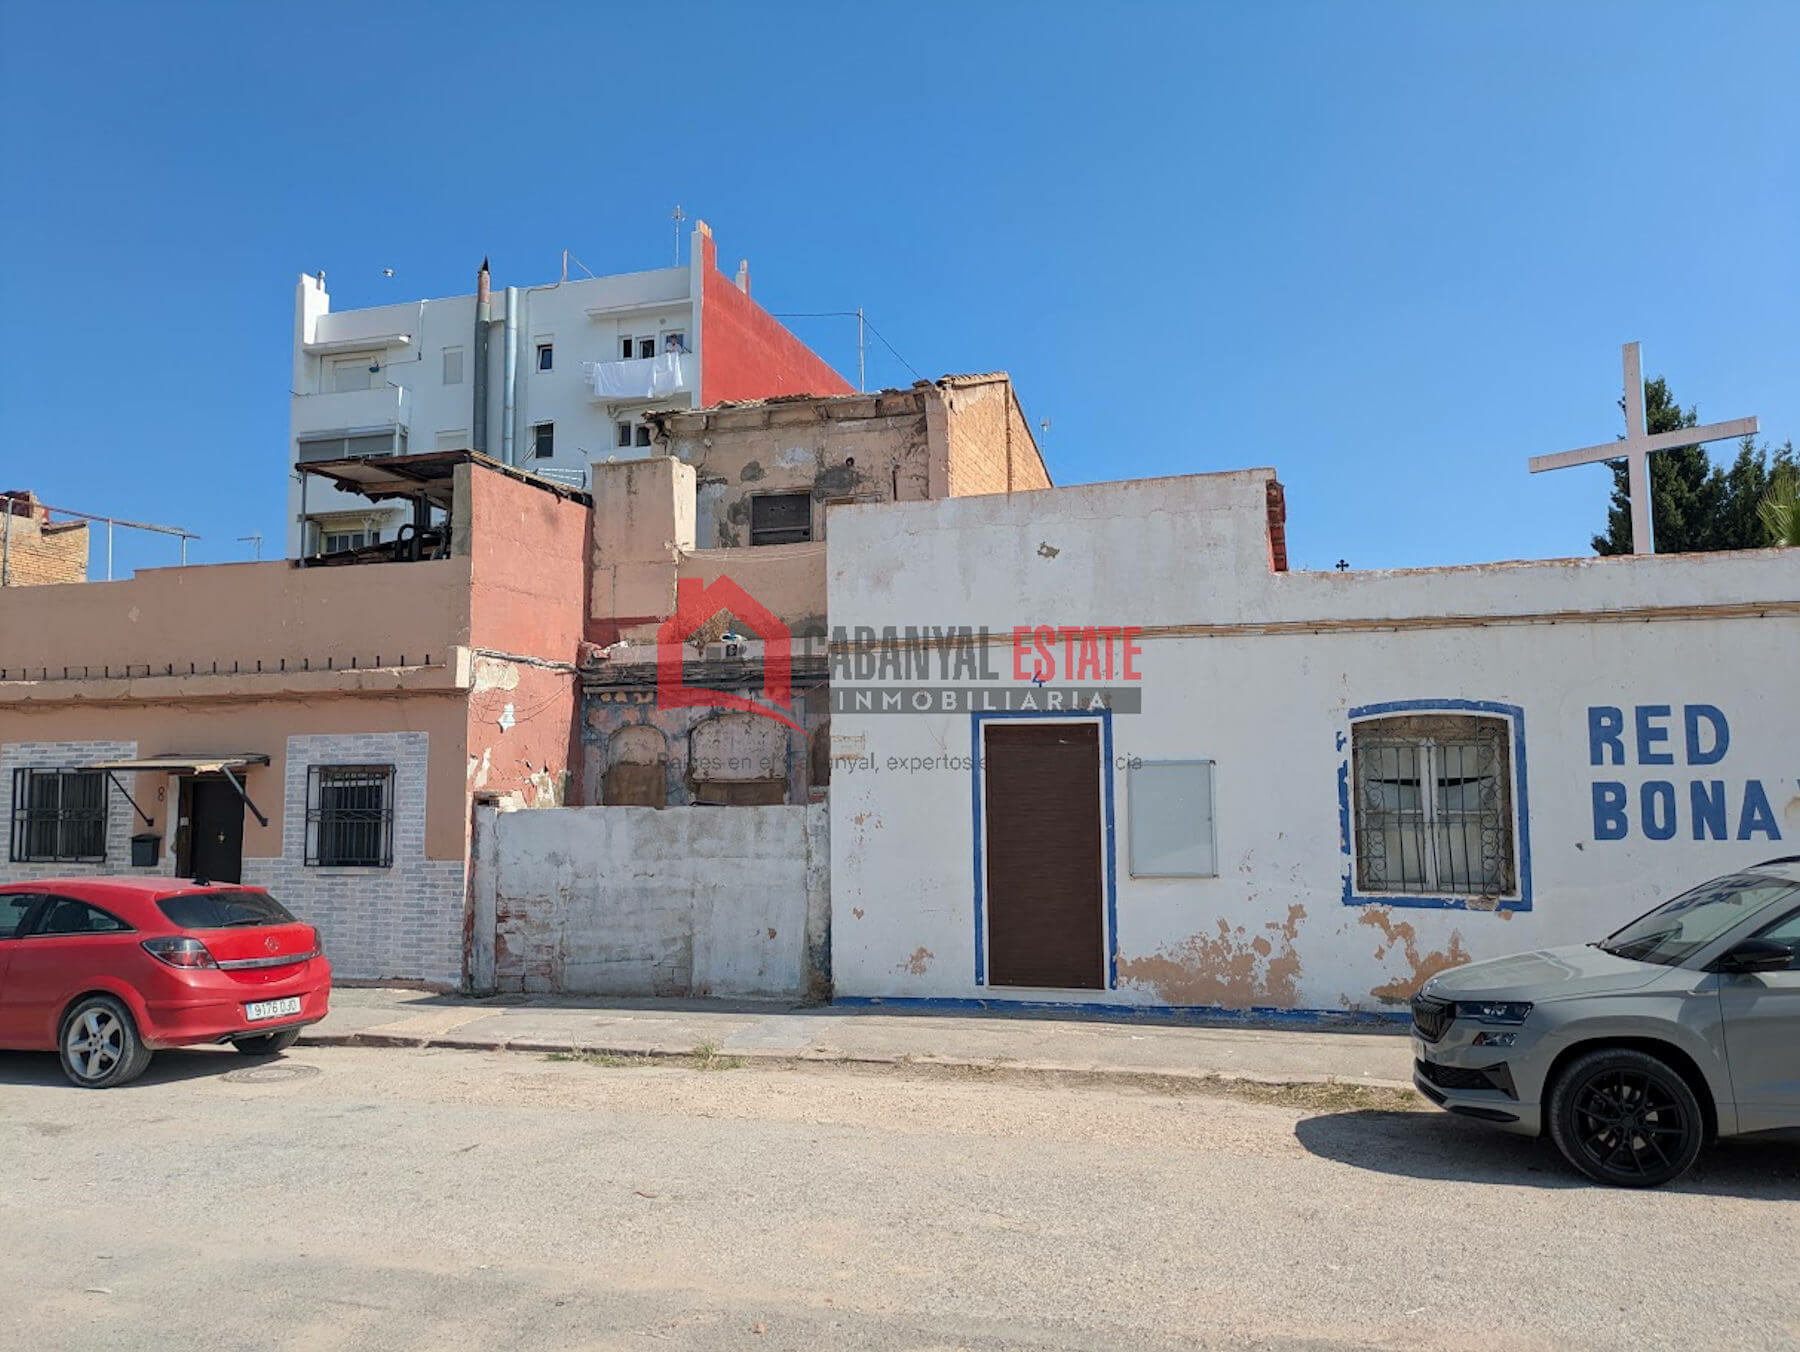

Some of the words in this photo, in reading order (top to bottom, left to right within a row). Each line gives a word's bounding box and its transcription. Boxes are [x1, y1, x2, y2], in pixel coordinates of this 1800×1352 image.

[1587, 704, 1730, 766] RED
[157, 786, 166, 802] 8
[1591, 779, 1800, 841] BONA
[254, 1002, 278, 1016] 9176
